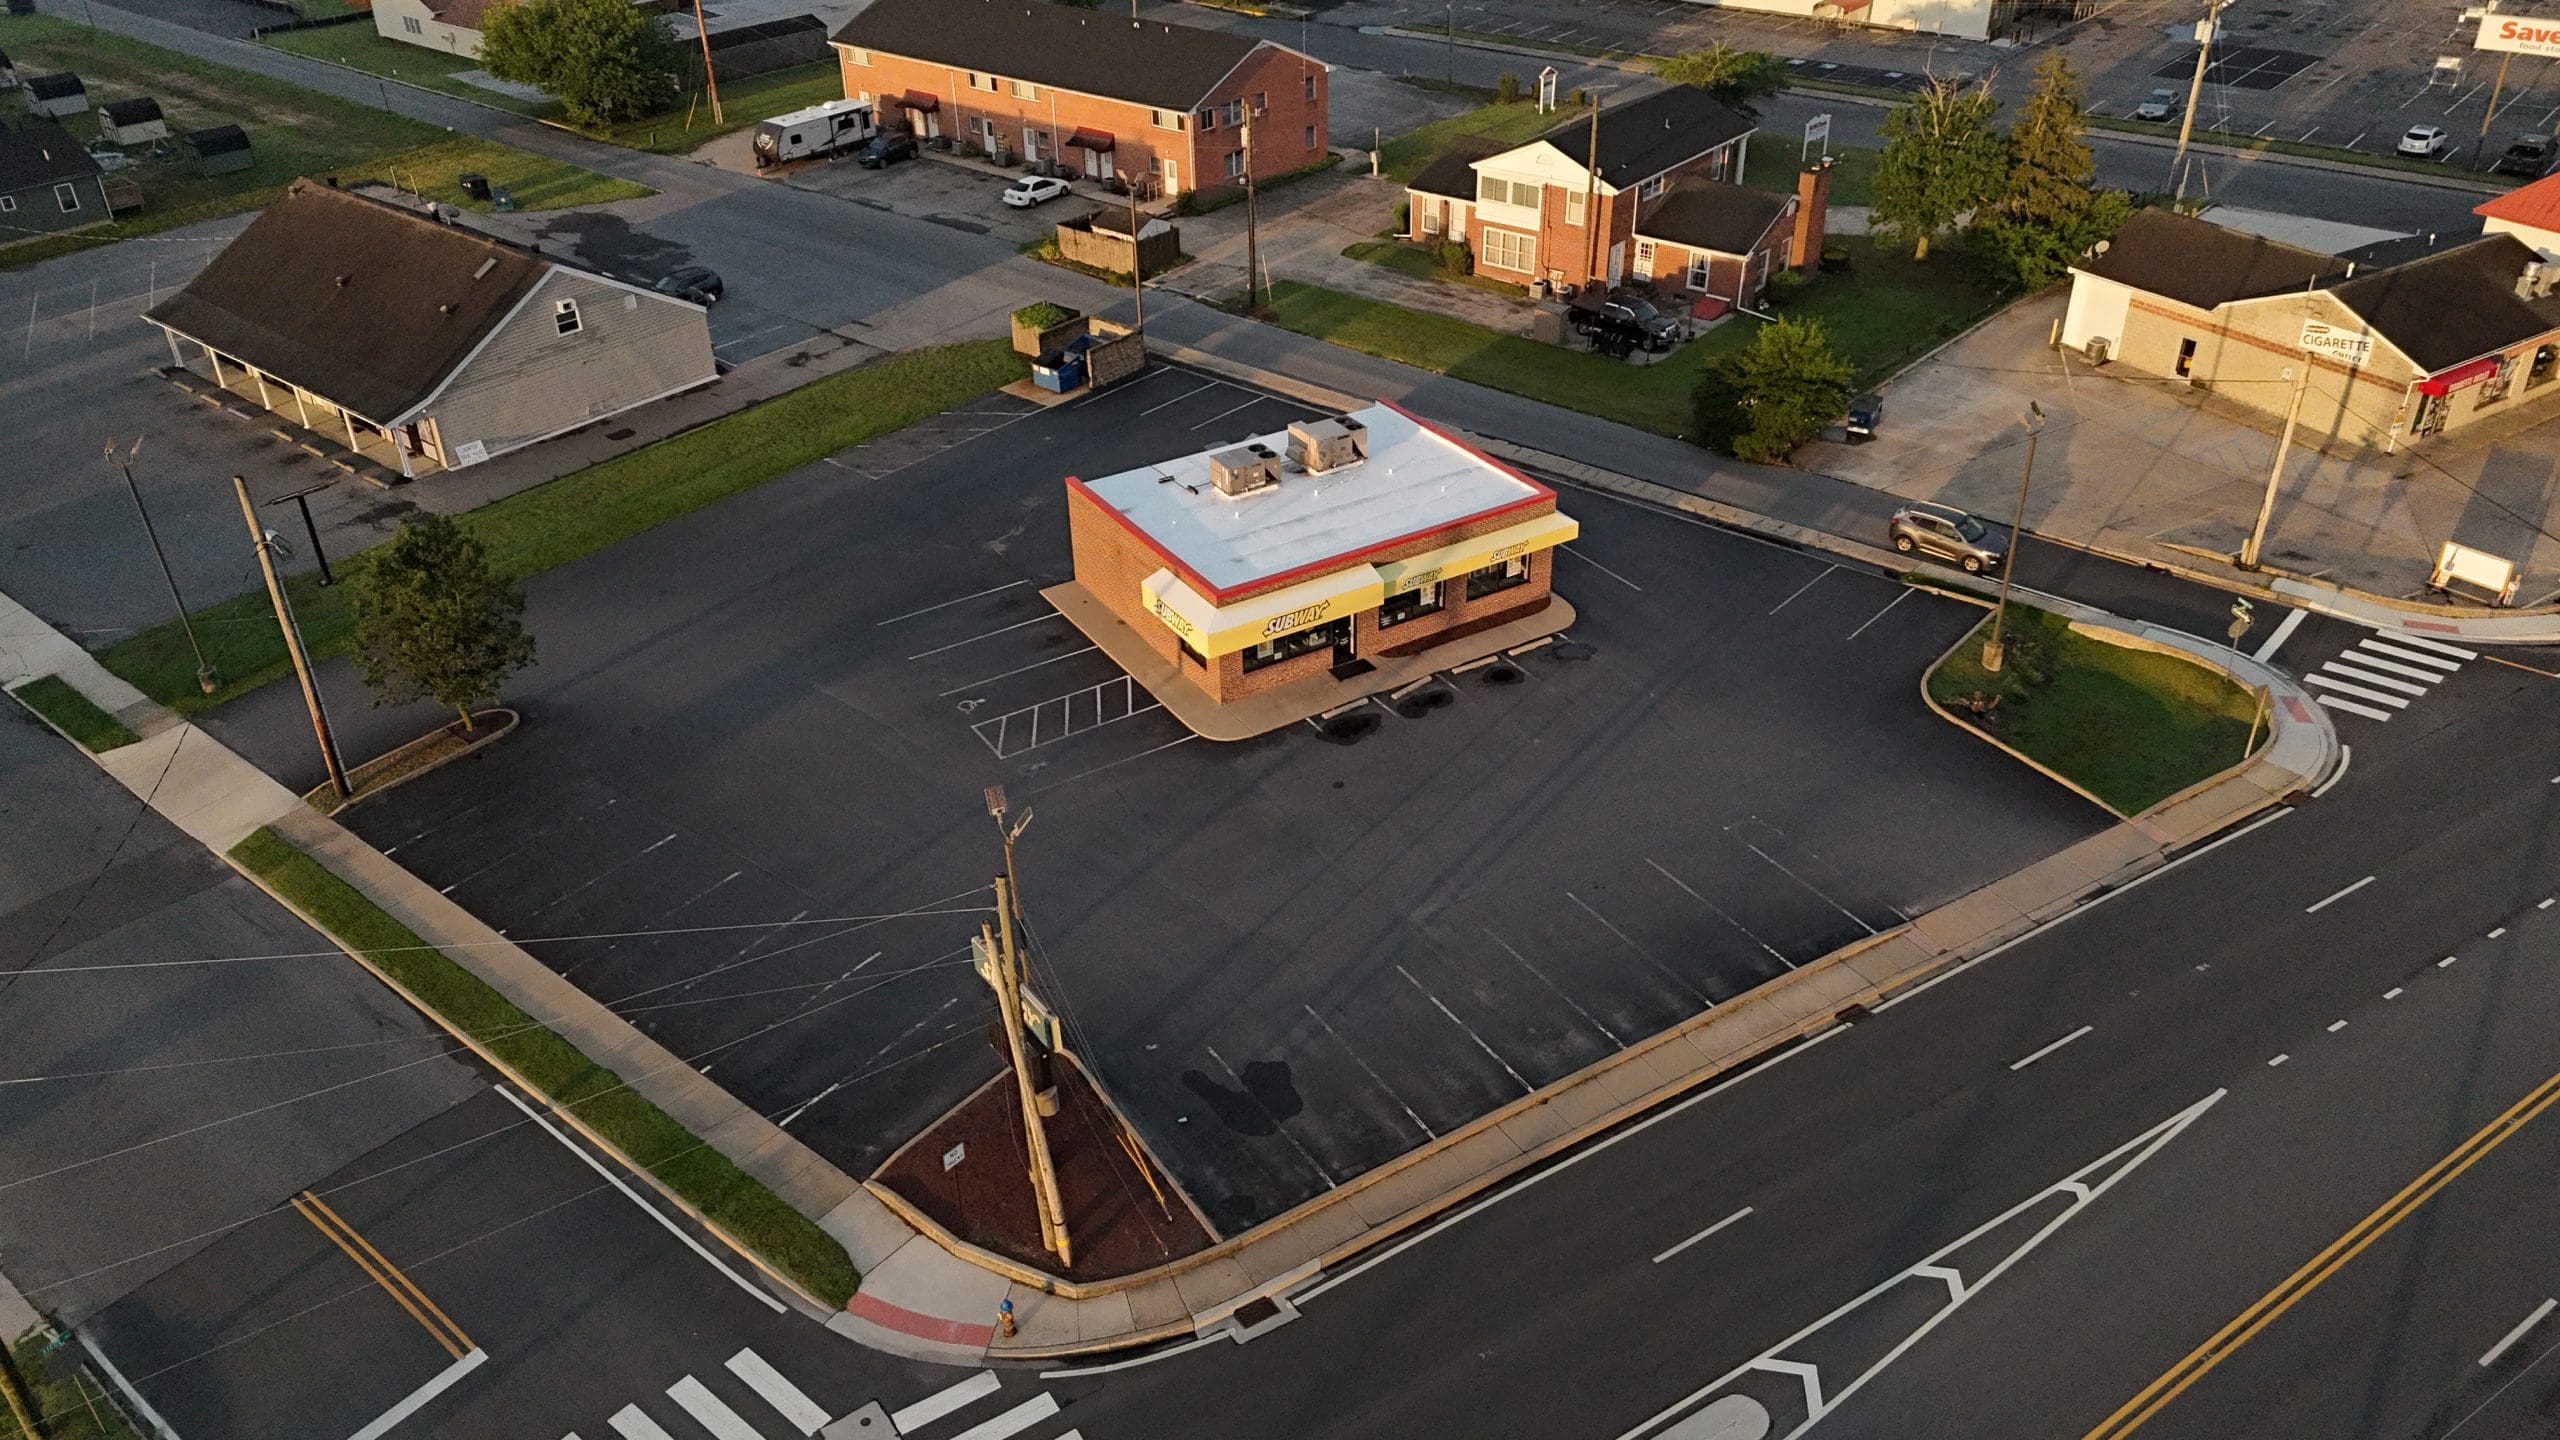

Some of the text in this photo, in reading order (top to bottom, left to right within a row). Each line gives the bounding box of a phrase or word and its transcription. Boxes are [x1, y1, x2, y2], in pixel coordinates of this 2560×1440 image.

[2499, 21, 2560, 45] Save
[2519, 42, 2542, 51] food
[2303, 334, 2370, 352] CIGARETTE
[1490, 539, 1530, 562] SUBWAY
[1402, 567, 1443, 590] SUBWAY
[1154, 598, 1194, 637] SUBWAY
[1262, 600, 1330, 638] SUBWAY
